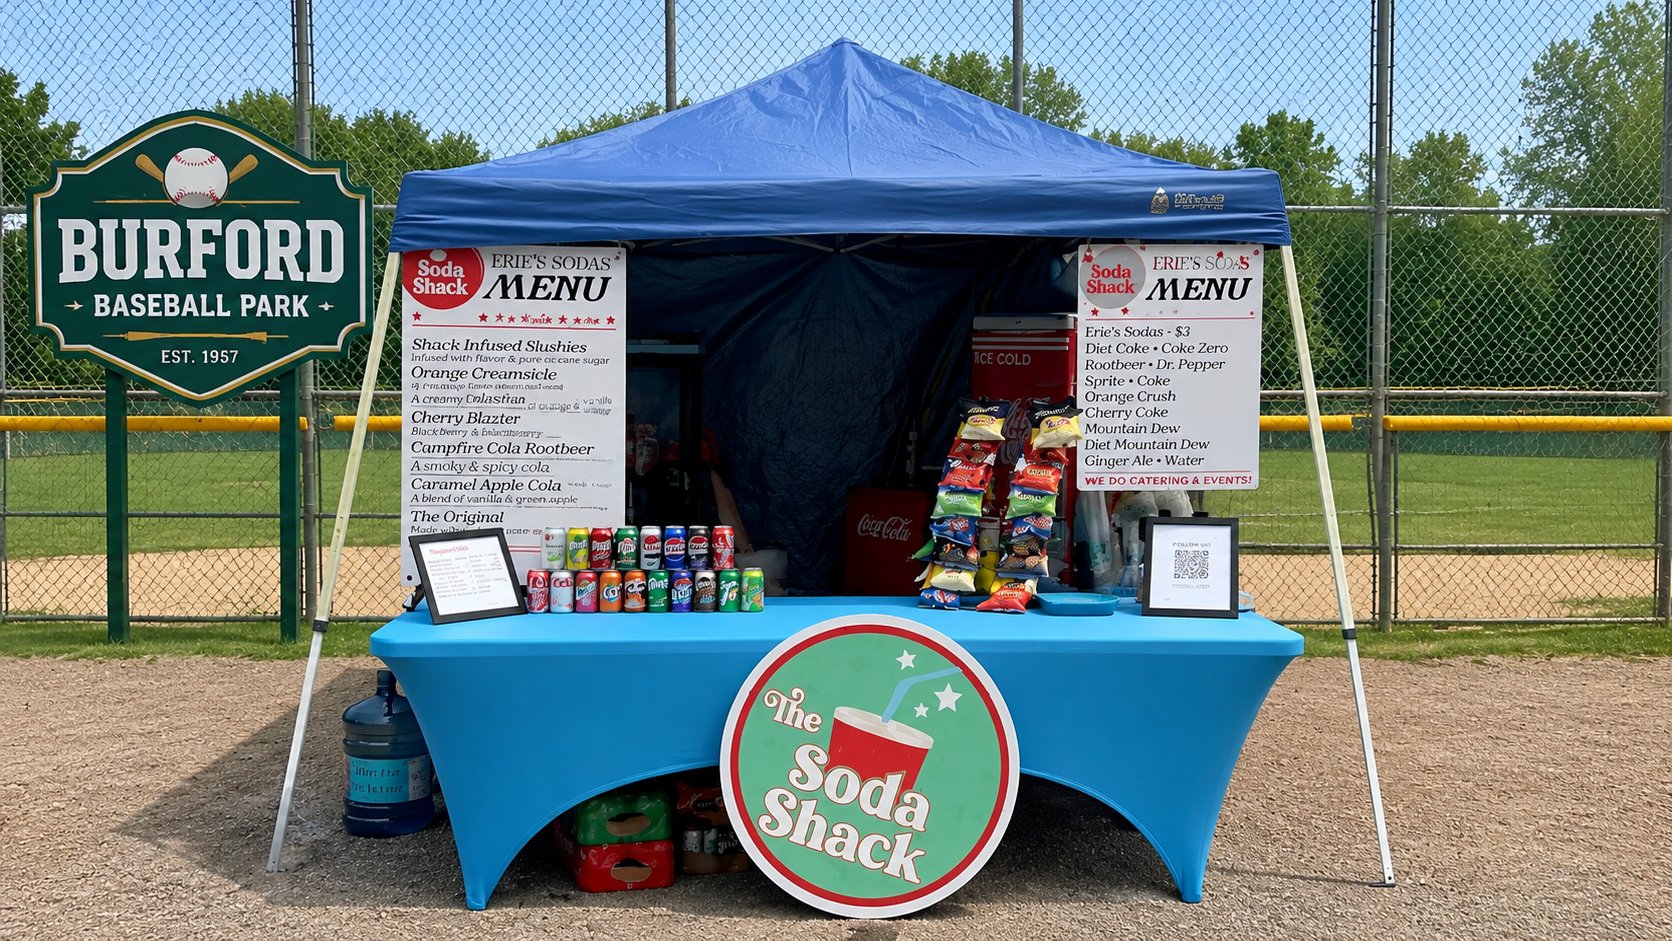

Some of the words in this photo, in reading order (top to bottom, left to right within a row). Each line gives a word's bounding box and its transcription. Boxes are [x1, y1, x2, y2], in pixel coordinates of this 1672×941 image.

[58, 218, 345, 284] BURFORD
[417, 259, 465, 278] Soda
[491, 253, 547, 270] ERIE'S
[551, 255, 611, 271] SODAS
[1153, 255, 1201, 270] ERIE'S
[1205, 255, 1250, 270] SODAS
[1091, 264, 1132, 279] Soda
[413, 278, 468, 295] Shack
[482, 274, 612, 302] MENU
[1086, 279, 1135, 294] Shack
[1145, 278, 1252, 301] MENU
[94, 294, 231, 317] BASEBALL
[240, 294, 309, 317] PARK
[1085, 326, 1121, 338] Erie's
[1123, 326, 1164, 338] Sodas
[1175, 326, 1191, 338] $3
[412, 338, 460, 351] Shack
[464, 339, 522, 352] Infused
[525, 340, 587, 353] Slushies
[1085, 343, 1112, 354] Diet
[1116, 343, 1149, 354] Coke
[1162, 343, 1195, 354] Coke
[1198, 343, 1228, 354] Zero
[161, 350, 195, 364] EST.
[202, 350, 239, 364] 1957
[411, 353, 448, 363] Infused
[450, 354, 472, 363] with
[475, 354, 505, 363] flavor
[508, 355, 516, 363] &
[518, 356, 542, 365] pure
[557, 356, 580, 364] cane
[582, 357, 610, 366] sugar
[997, 353, 1031, 366] COLD
[1085, 359, 1146, 370] Rootbeer
[1156, 359, 1175, 370] Dr.
[1178, 359, 1225, 372] Pepper
[411, 366, 468, 382] Orange
[471, 367, 557, 380] Creamsicle
[1085, 375, 1125, 388] Sprite
[1137, 375, 1171, 386] Coke
[411, 394, 420, 404] A
[1085, 391, 1134, 405] Orange
[1137, 391, 1176, 402] Crush
[411, 411, 464, 426] Cherry
[465, 411, 521, 424] Blazter
[1085, 407, 1132, 420] Cherry
[1135, 407, 1169, 418] Coke
[1084, 423, 1147, 434] Mountain
[1151, 423, 1181, 434] Dew
[411, 441, 483, 457] Campfire
[486, 442, 521, 455] Cola
[524, 442, 595, 455] Rootbeer
[1085, 439, 1112, 450] Diet
[1114, 439, 1178, 450] Mountain
[1181, 439, 1210, 450] Dew
[410, 460, 421, 472] A
[423, 461, 466, 474] smoky
[468, 461, 479, 472] &
[482, 461, 518, 474] spicy
[521, 461, 550, 473] cola
[1085, 455, 1129, 469] Ginger
[1132, 455, 1153, 466] Ale
[1165, 455, 1204, 466] Water
[411, 478, 477, 491] Caramel
[479, 479, 524, 493] Apple
[527, 479, 562, 492] Cola
[1084, 476, 1105, 486] WE
[1109, 476, 1126, 486] DO
[1129, 476, 1190, 486] CATERING
[1192, 476, 1200, 485] &
[1204, 475, 1252, 485] EVENTS!
[410, 494, 420, 503] A
[421, 494, 452, 503] blend
[454, 494, 466, 504] of
[466, 494, 502, 504] vanilla
[505, 494, 513, 504] &
[549, 495, 578, 505] apple
[411, 510, 440, 523] The
[443, 511, 504, 526] Original
[763, 687, 823, 733] The
[787, 744, 931, 832] Soda
[757, 787, 926, 884] Shack
